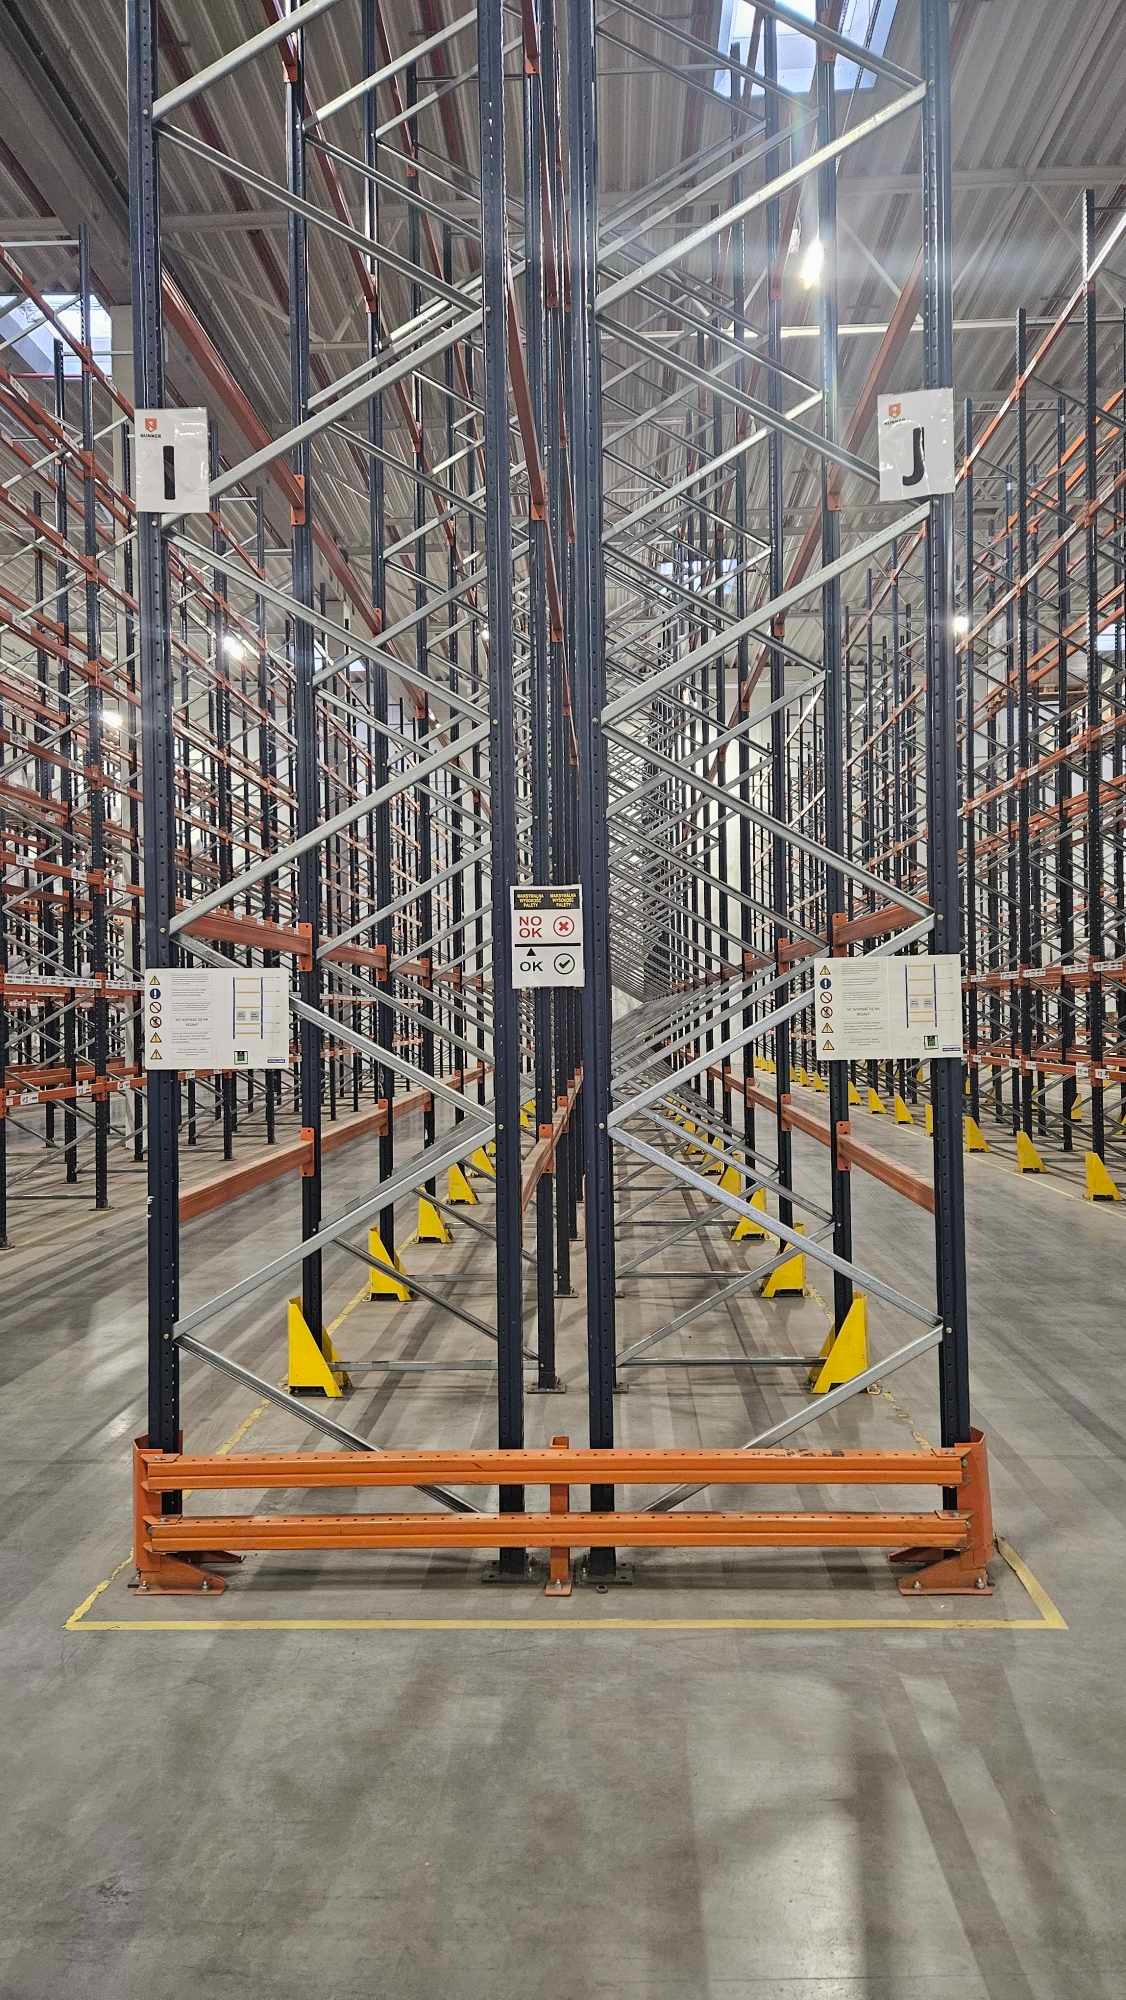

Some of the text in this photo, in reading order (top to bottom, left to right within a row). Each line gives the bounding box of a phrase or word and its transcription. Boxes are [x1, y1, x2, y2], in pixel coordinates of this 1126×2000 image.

[902, 427, 925, 486] J
[163, 445, 176, 500] I
[519, 915, 542, 926] NO
[519, 928, 542, 938] OK
[520, 961, 543, 972] OK
